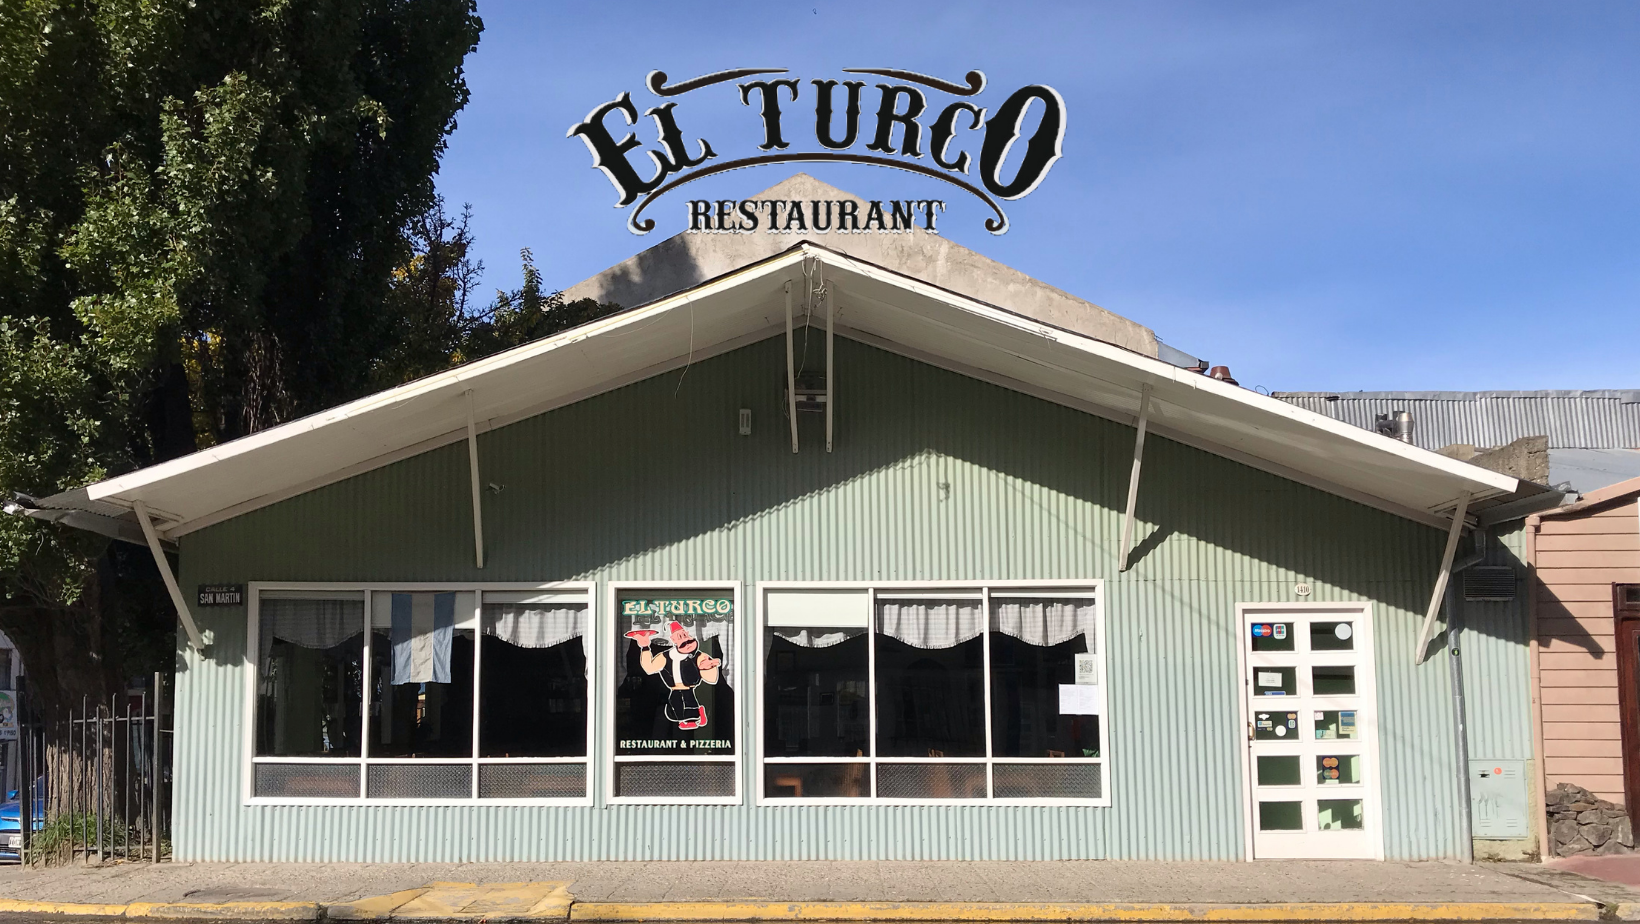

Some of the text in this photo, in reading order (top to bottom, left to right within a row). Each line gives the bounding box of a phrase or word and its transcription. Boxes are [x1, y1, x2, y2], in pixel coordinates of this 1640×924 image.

[1297, 585, 1310, 593] 1410
[200, 592, 240, 604] SAN MARTIN
[622, 598, 731, 615] EL TURCO
[620, 740, 731, 748] RESTAURANT & PIZZERIA
